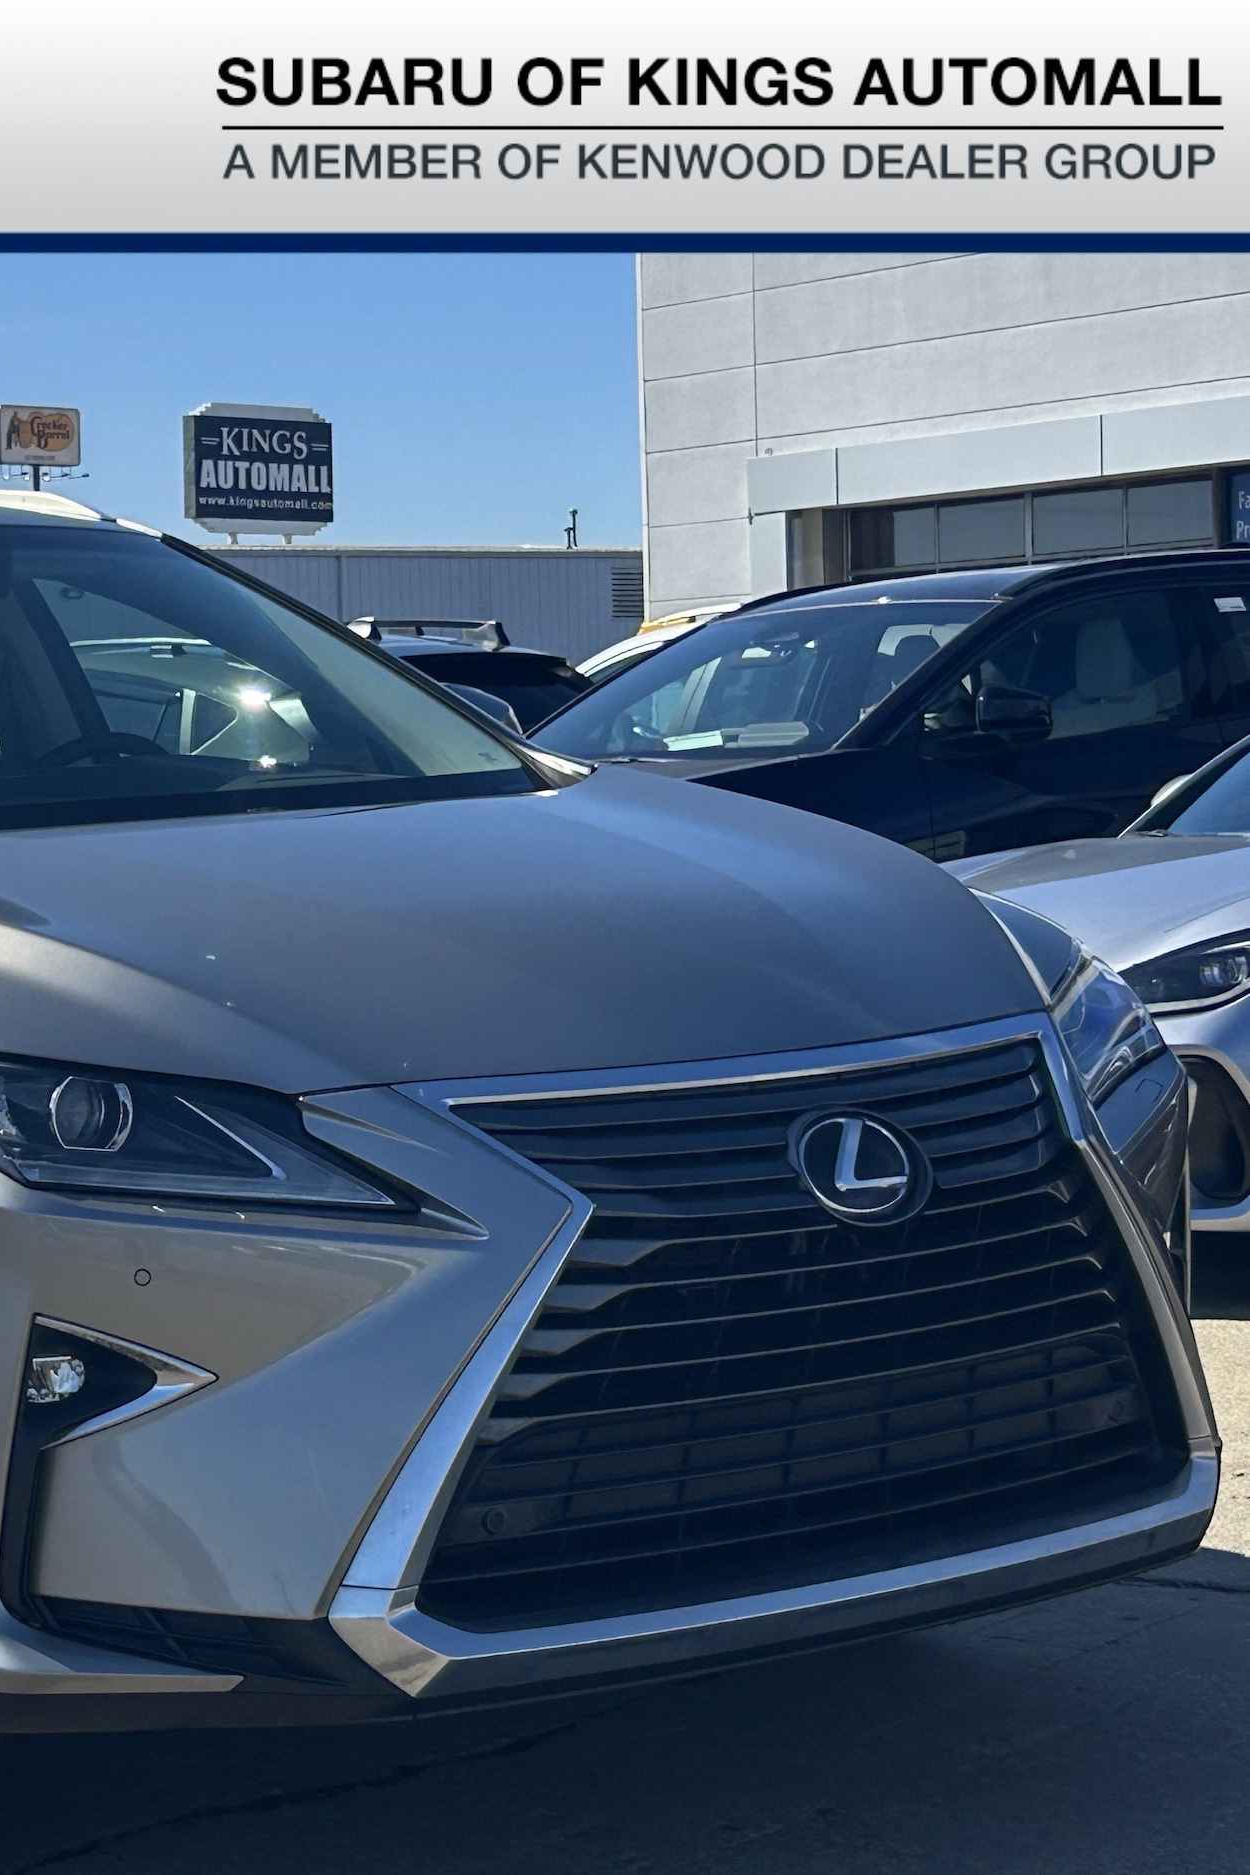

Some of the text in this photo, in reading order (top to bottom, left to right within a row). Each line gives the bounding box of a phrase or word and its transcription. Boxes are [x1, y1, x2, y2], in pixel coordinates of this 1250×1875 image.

[31, 416, 70, 437] Cracker
[220, 427, 308, 460] KINGS
[199, 459, 331, 493] AUTOMALL
[1236, 520, 1250, 539] Pr
